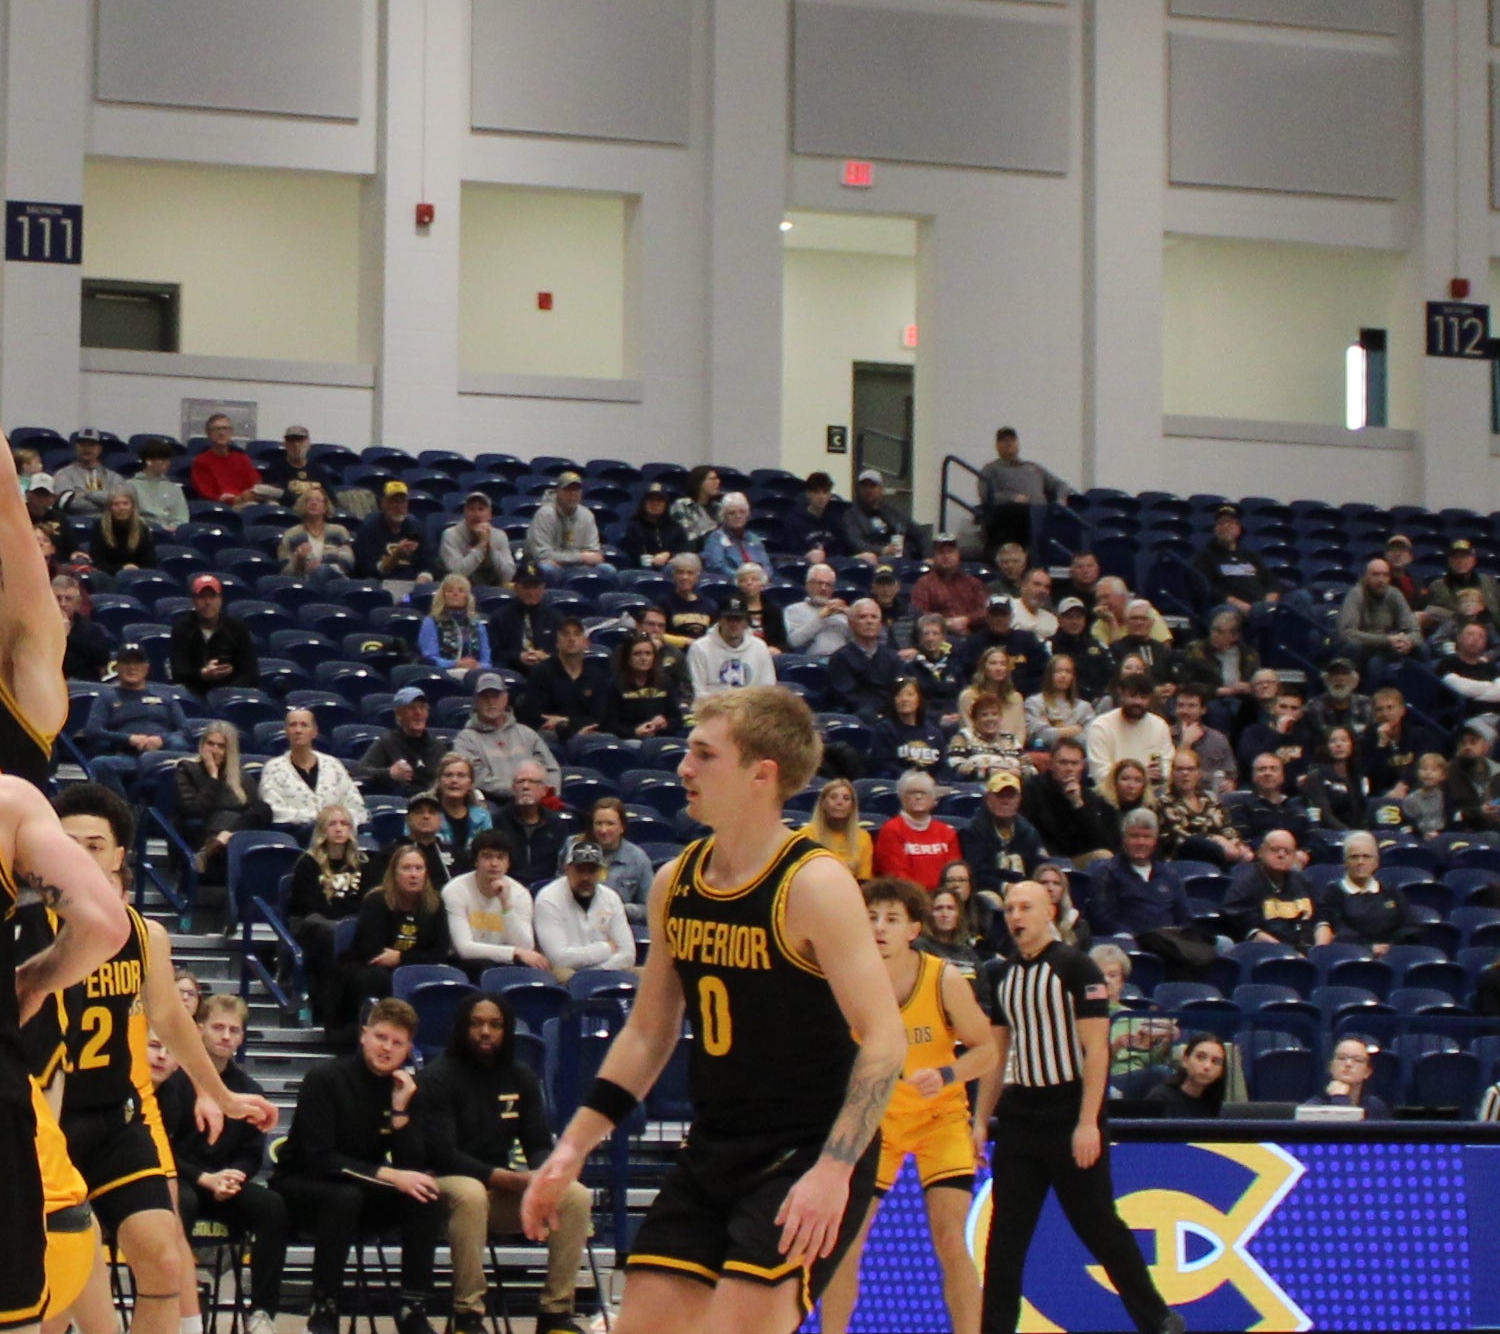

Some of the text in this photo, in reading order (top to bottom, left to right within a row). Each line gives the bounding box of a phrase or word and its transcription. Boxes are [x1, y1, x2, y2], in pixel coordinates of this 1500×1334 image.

[17, 216, 73, 260] 111
[1433, 315, 1484, 355] 112
[666, 916, 772, 970] SUPERIOR
[85, 959, 142, 999] ERIOR
[79, 1005, 113, 1070] 2
[698, 975, 733, 1057] 0
